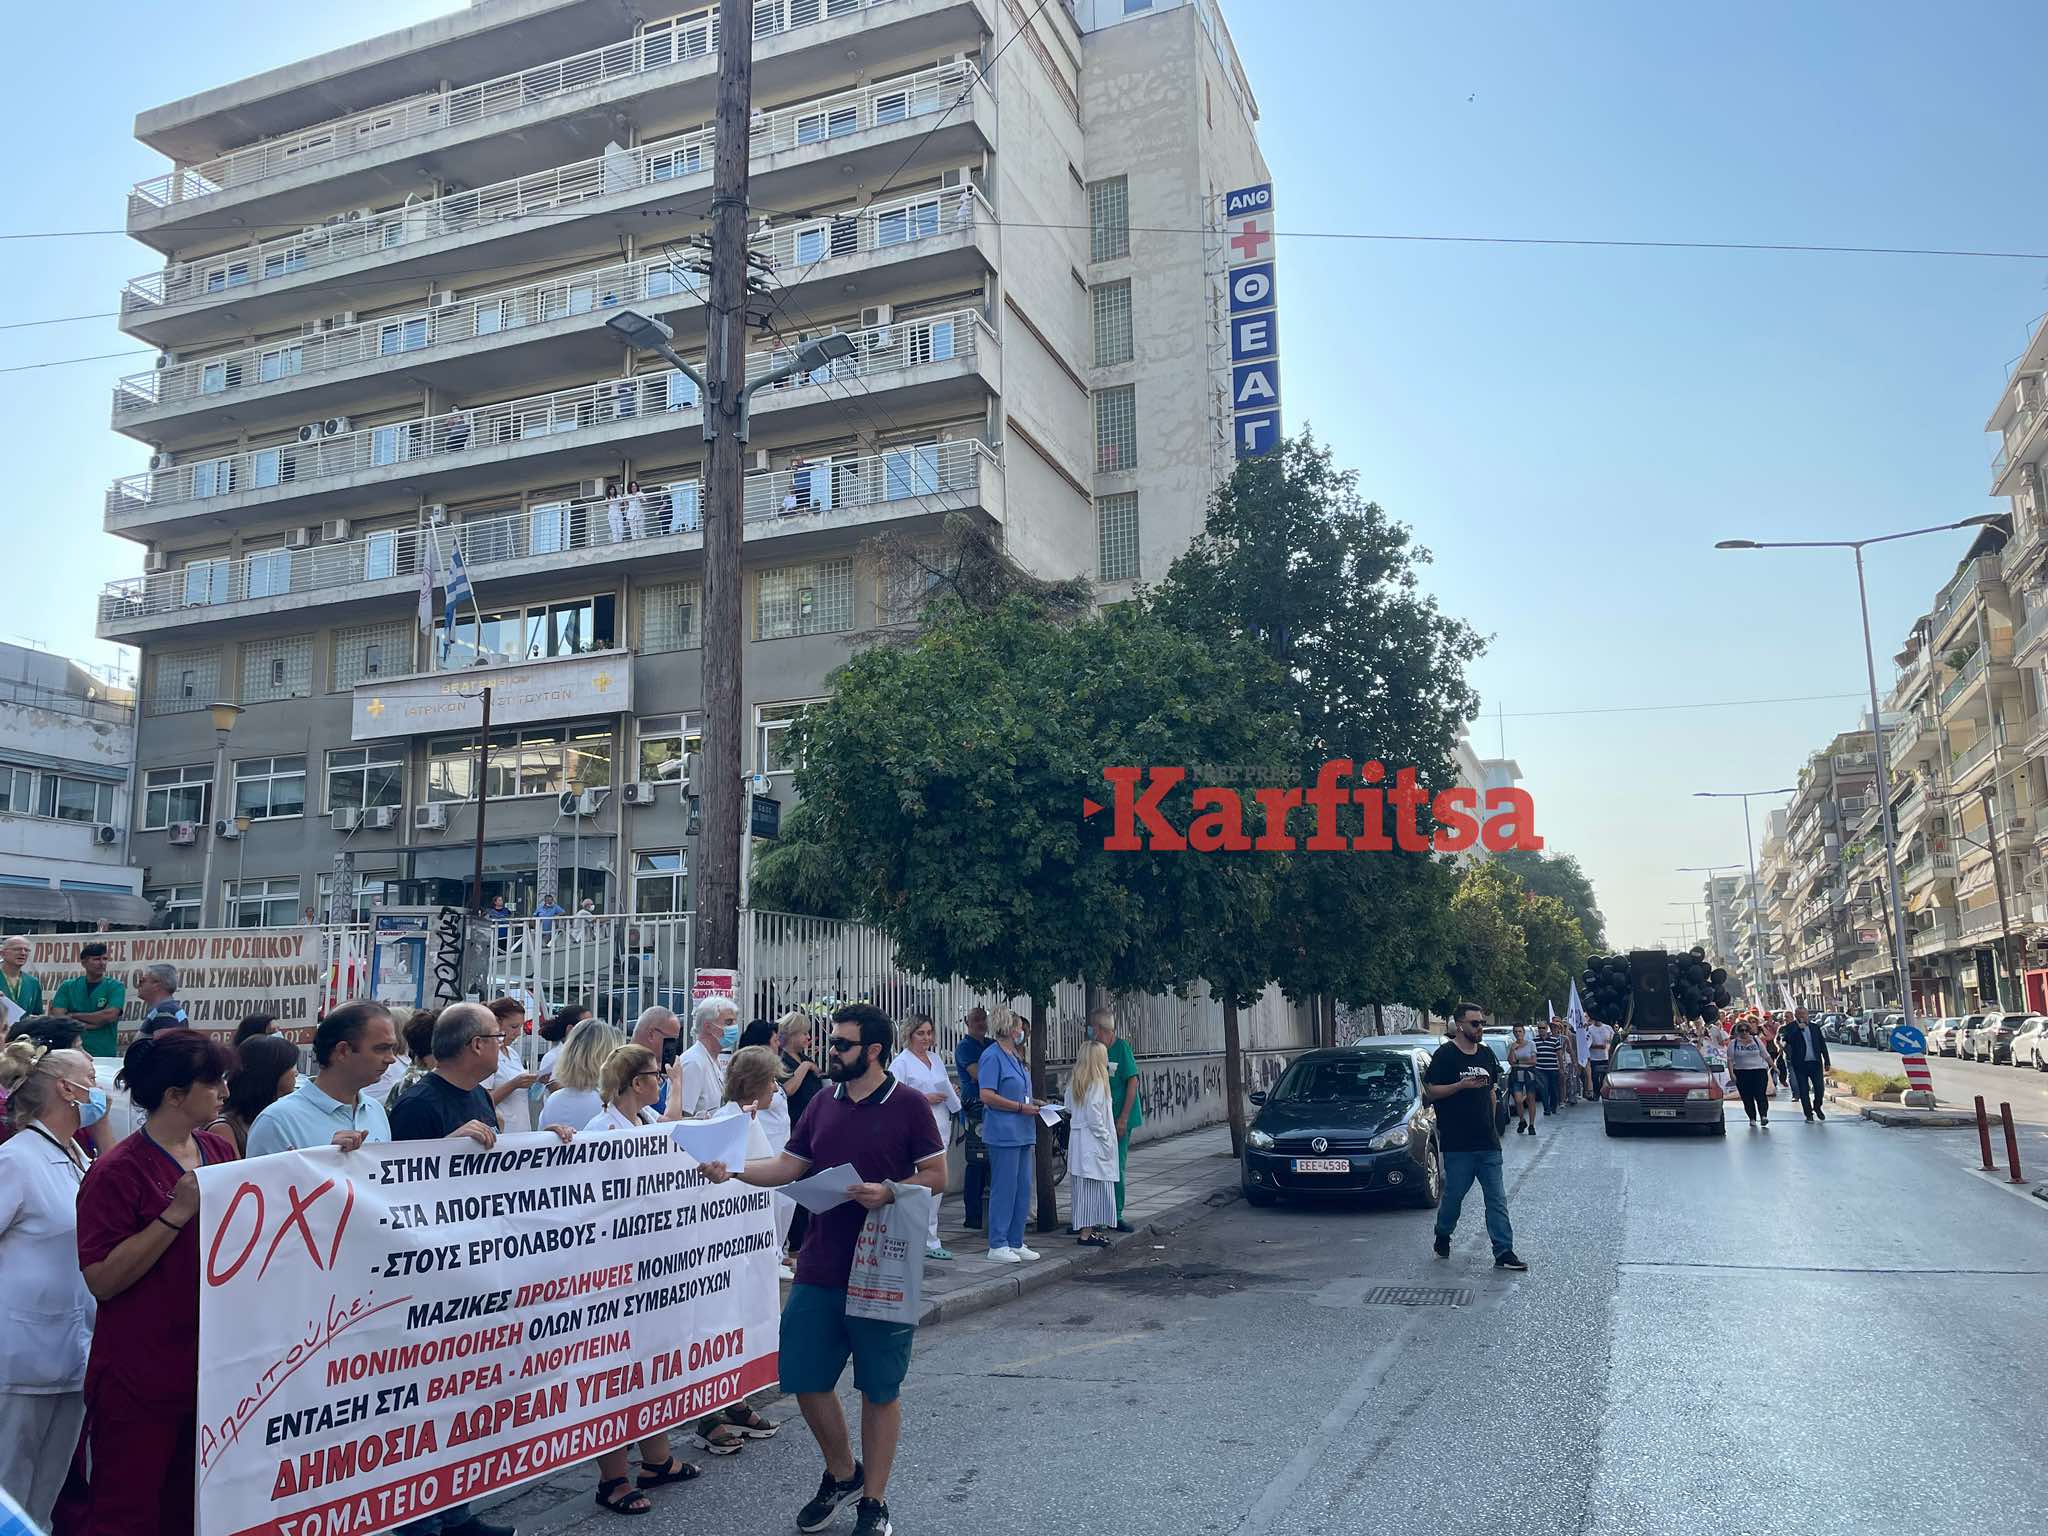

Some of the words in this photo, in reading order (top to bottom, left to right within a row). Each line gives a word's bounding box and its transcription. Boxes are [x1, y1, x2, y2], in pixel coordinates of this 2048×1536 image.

[1229, 190, 1270, 212] ΑΝΘ
[404, 701, 467, 718] ΙΑΤΡΙΚΟΝ
[490, 687, 572, 708] ΝΣΤΙΤΟΥΤΟΝ
[33, 941, 126, 963] ΠΡΟΣΛΕΙΣ
[131, 938, 207, 961] ΜΟΝΙΜΟΥ
[194, 1000, 210, 1021] ΤΑ
[449, 1135, 668, 1178] ΕΜΠΟΡΕΥΜΑΤΟΠΟΙΗΣΗ
[207, 1178, 355, 1287] ΟΧΙ
[435, 1182, 596, 1225] ΑΠΟΓΕΥΜΑΤΙΝΑ
[602, 1178, 631, 1201] ΕΠΙ
[469, 1222, 596, 1266] ΕΡΓΟΛΑΒΟΥΣ
[612, 1210, 672, 1240] ΙΔΙΩΤΕΣ
[676, 1205, 697, 1228] ΣΤΑ
[700, 1191, 771, 1222] ΝΟΣΟΚΟΜΕΙΑ
[407, 1289, 513, 1330] ΜΑΖΙΚΕΣ
[514, 1263, 633, 1309] ΠΡΟΣΛΗΨΕΙΣ
[638, 1247, 704, 1282] ΜΟΝΙΜΟΥ
[707, 1229, 775, 1264] ΠΡΟΣΩΠΙΚΟΥ
[326, 1322, 524, 1387] ΜΟΝΙΜΟΠΟΙΗΣΗ
[528, 1308, 582, 1341] ΟΛΩΝ
[587, 1299, 620, 1326] ΤΩΝ
[623, 1270, 731, 1317] ΣΥΜΒΑΣΙΟΥΧΩΝ
[265, 1394, 369, 1446] ΕΝΤΑΞΗ
[375, 1383, 419, 1416] ΣΤΑ
[426, 1363, 502, 1402] ΒΑΡΕΑ
[519, 1330, 631, 1379] ΑΝΘΥΓΙΕΙΝΑ
[271, 1420, 438, 1501] ΔΗΜΟΣΙΑ
[446, 1382, 568, 1448] ΔΩΡΕΑΝ
[576, 1361, 644, 1408] ΥΓΕΙΑ
[651, 1349, 682, 1386] ΓΙΑ
[688, 1328, 744, 1371] ΟΛΟΥΣ
[451, 1413, 628, 1497] ΕΡΓΑΖΟΜΕΝΩΝ
[638, 1372, 742, 1431] ΘΕΑΓΕΝΕΙΟΥ
